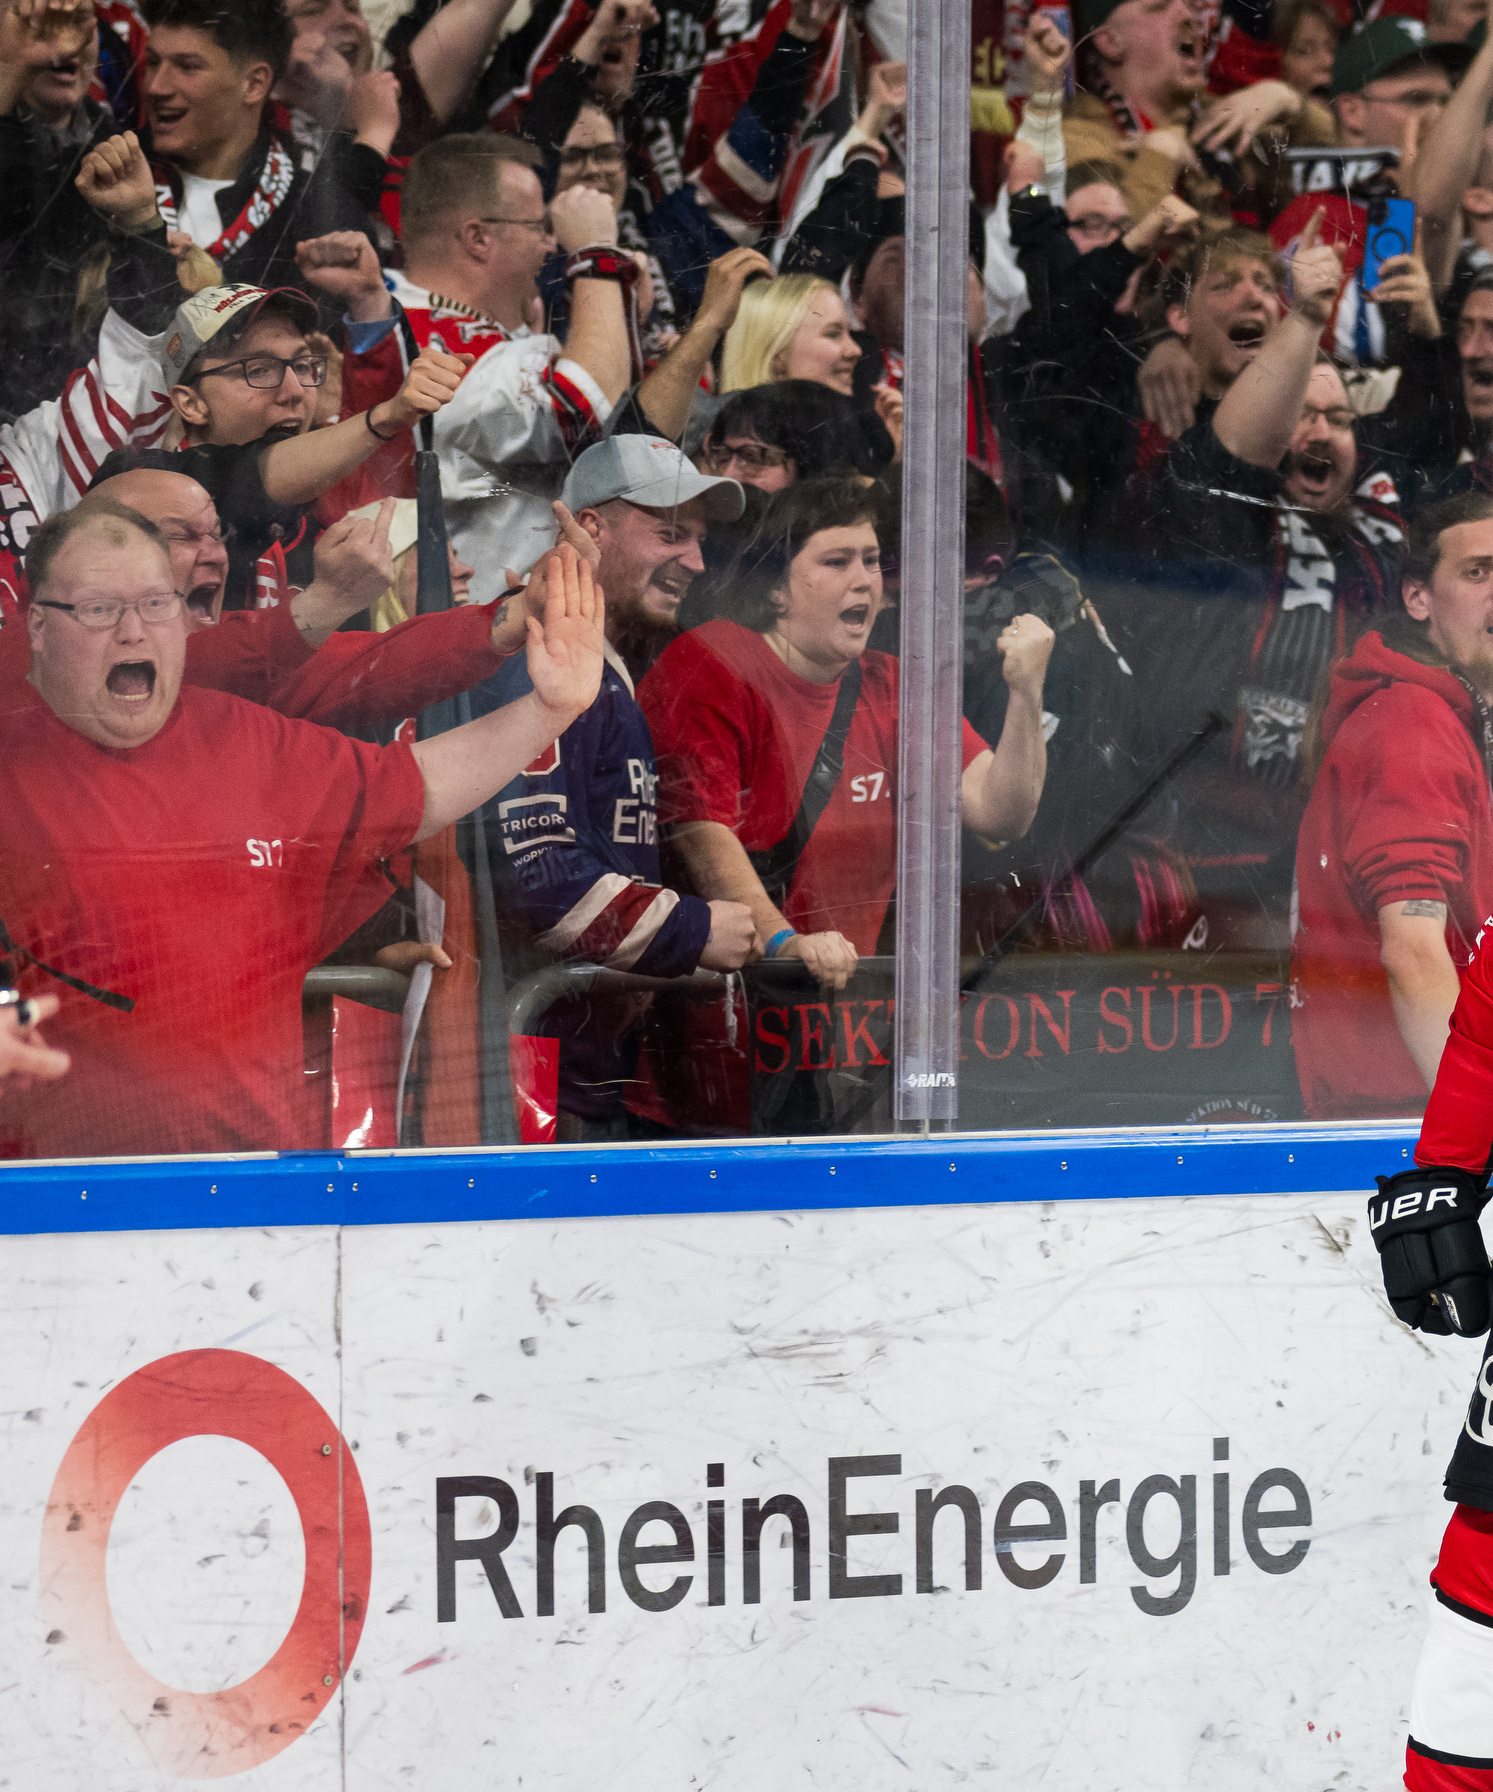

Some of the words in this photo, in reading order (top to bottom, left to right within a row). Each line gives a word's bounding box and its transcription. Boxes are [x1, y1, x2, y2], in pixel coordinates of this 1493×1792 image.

[755, 990, 1076, 1074] SEKON
[1098, 971, 1232, 1054] SÜD
[435, 1437, 1313, 1623] RheinEnergie
